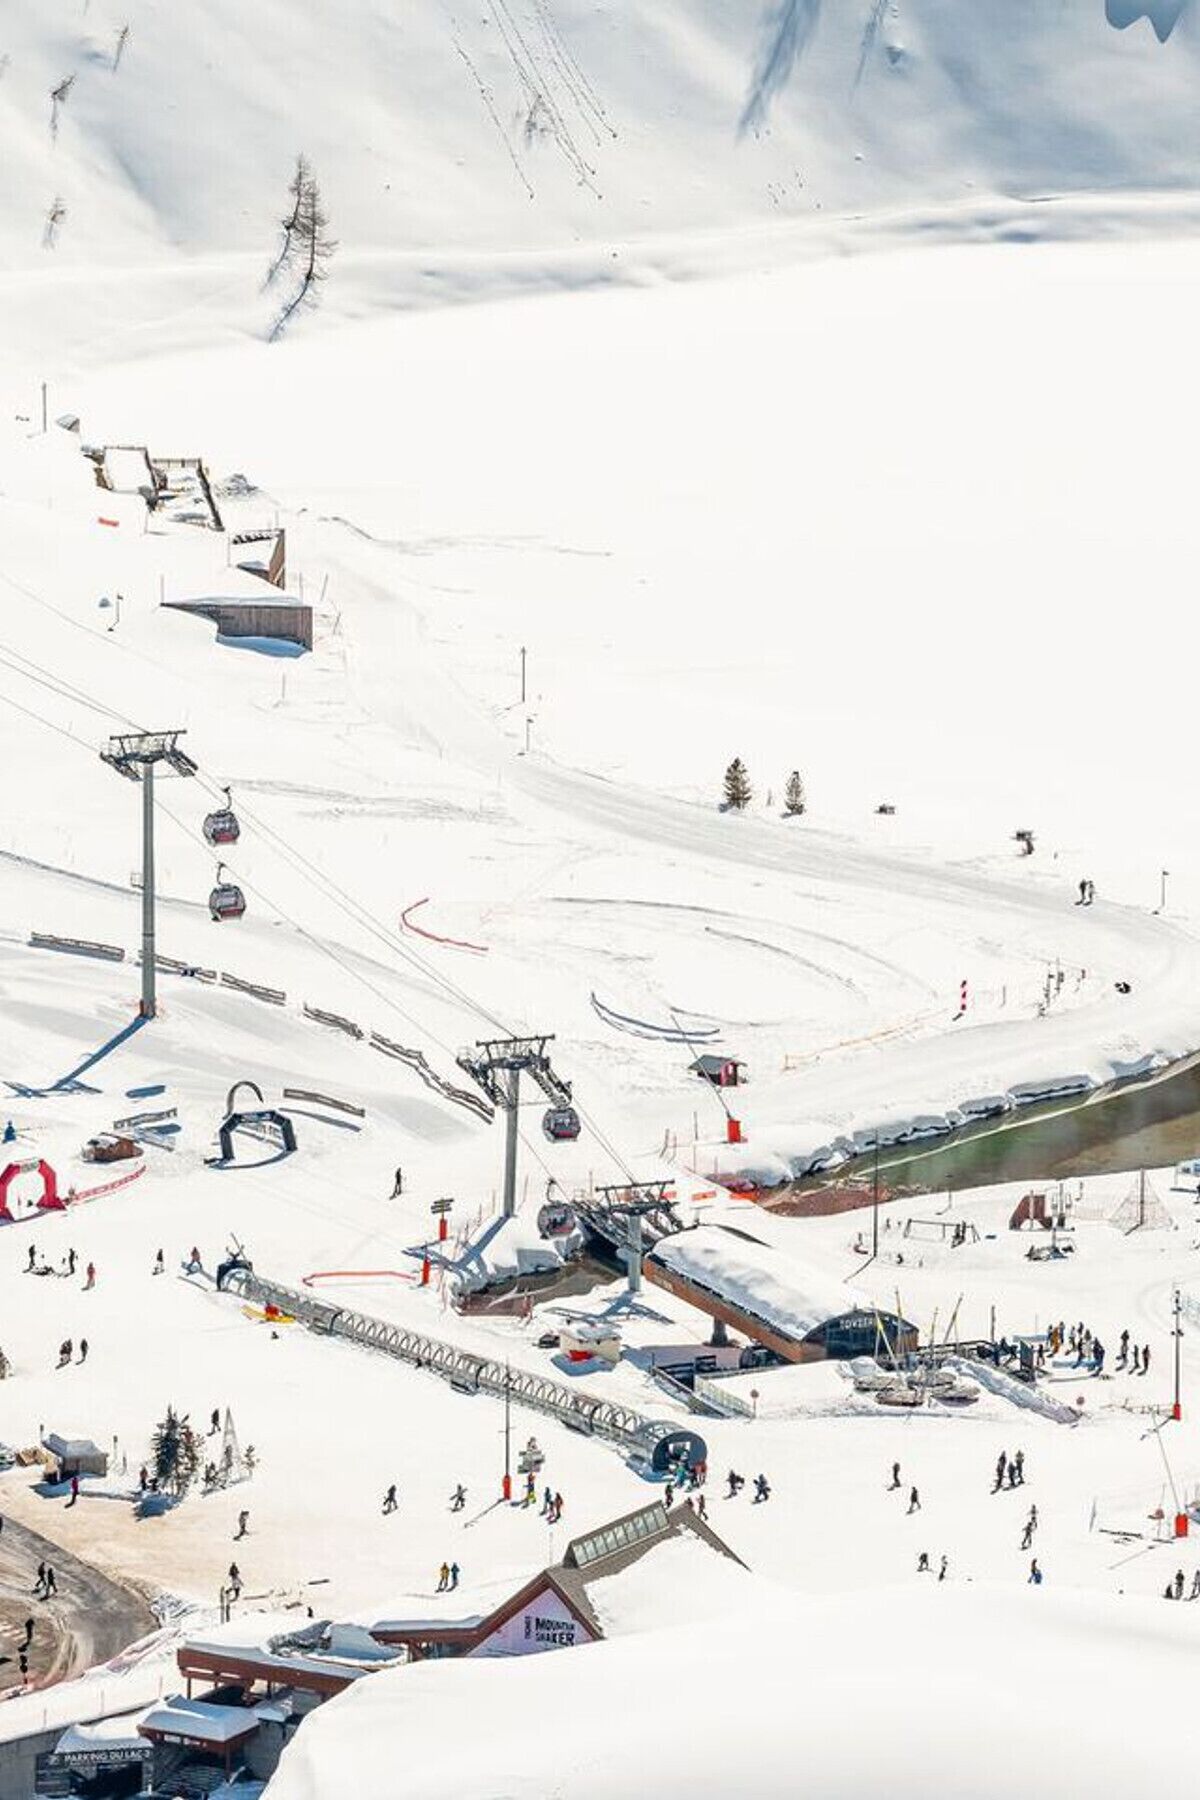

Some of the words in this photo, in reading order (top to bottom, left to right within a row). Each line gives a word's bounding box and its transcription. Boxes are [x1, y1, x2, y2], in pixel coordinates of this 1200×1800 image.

[64, 1752, 108, 1762] PARKING
[109, 1750, 124, 1760] DU
[124, 1749, 143, 1759] LAC
